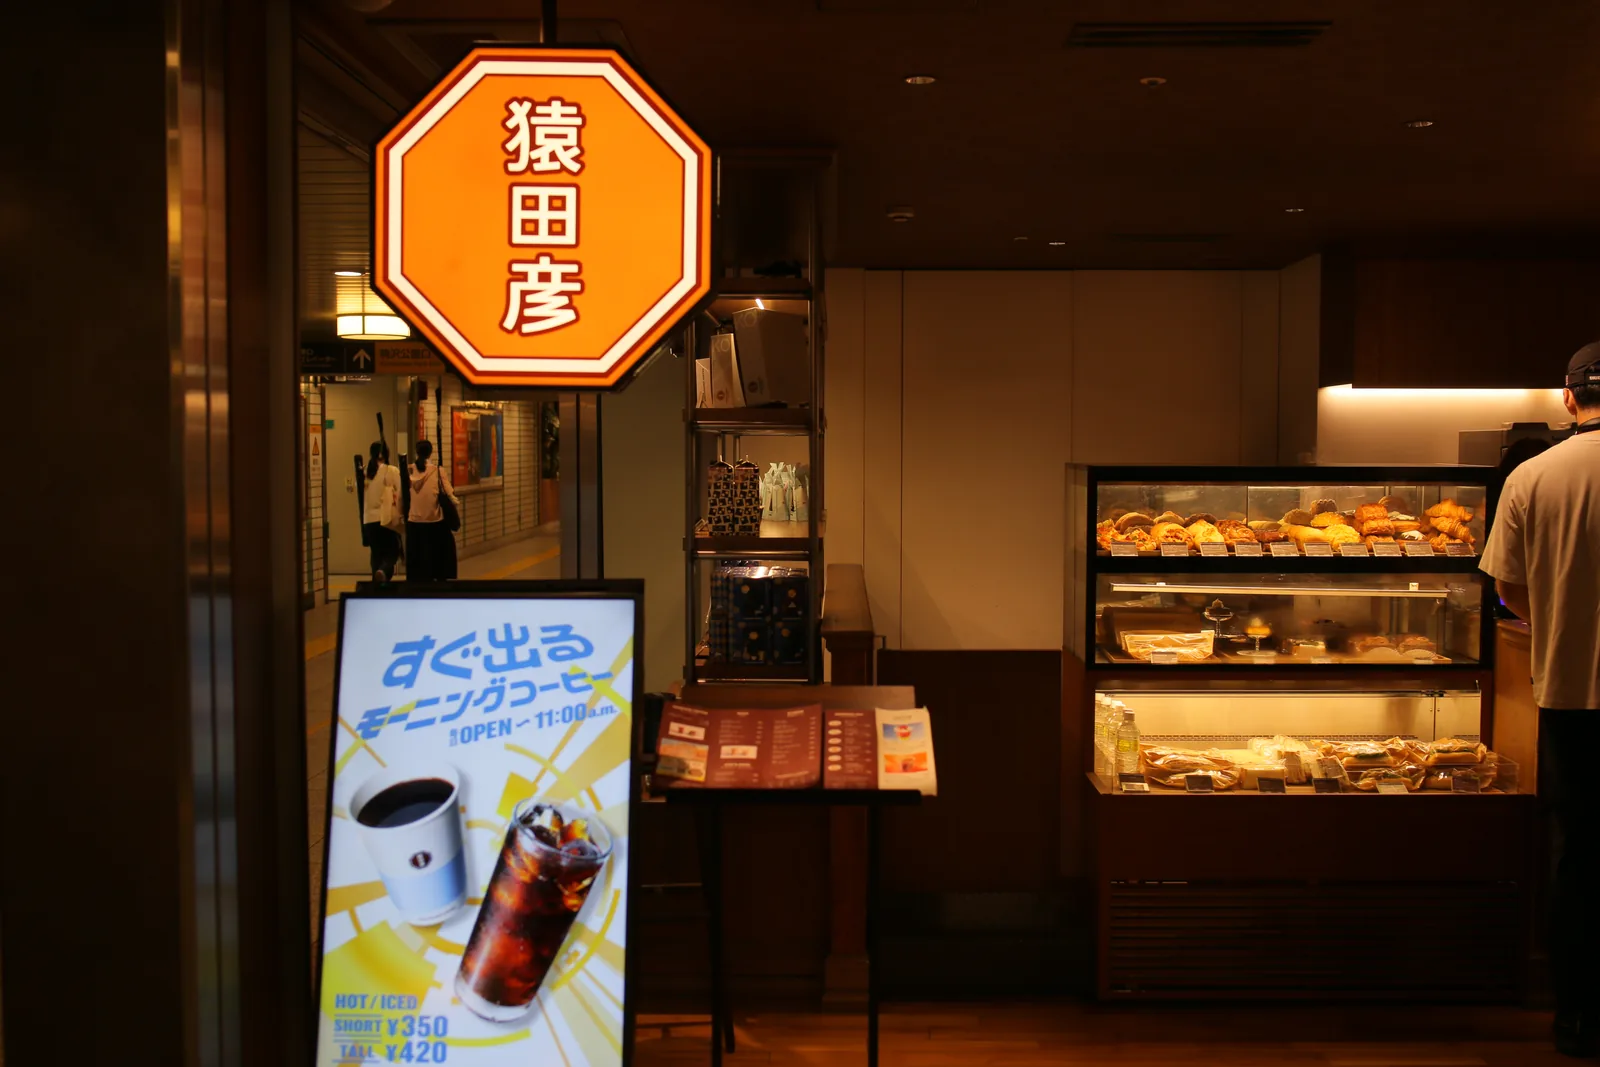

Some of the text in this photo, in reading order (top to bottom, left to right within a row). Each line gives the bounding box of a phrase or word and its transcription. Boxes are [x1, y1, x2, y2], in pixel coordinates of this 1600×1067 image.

[502, 98, 584, 334] 猿田彦
[382, 622, 594, 690] すぐ出る
[355, 671, 614, 740] モーニングコーヒー
[459, 717, 513, 745] OPEN
[333, 1014, 449, 1039] SHORT ¥350
[340, 1040, 447, 1064] TALL ¥420
